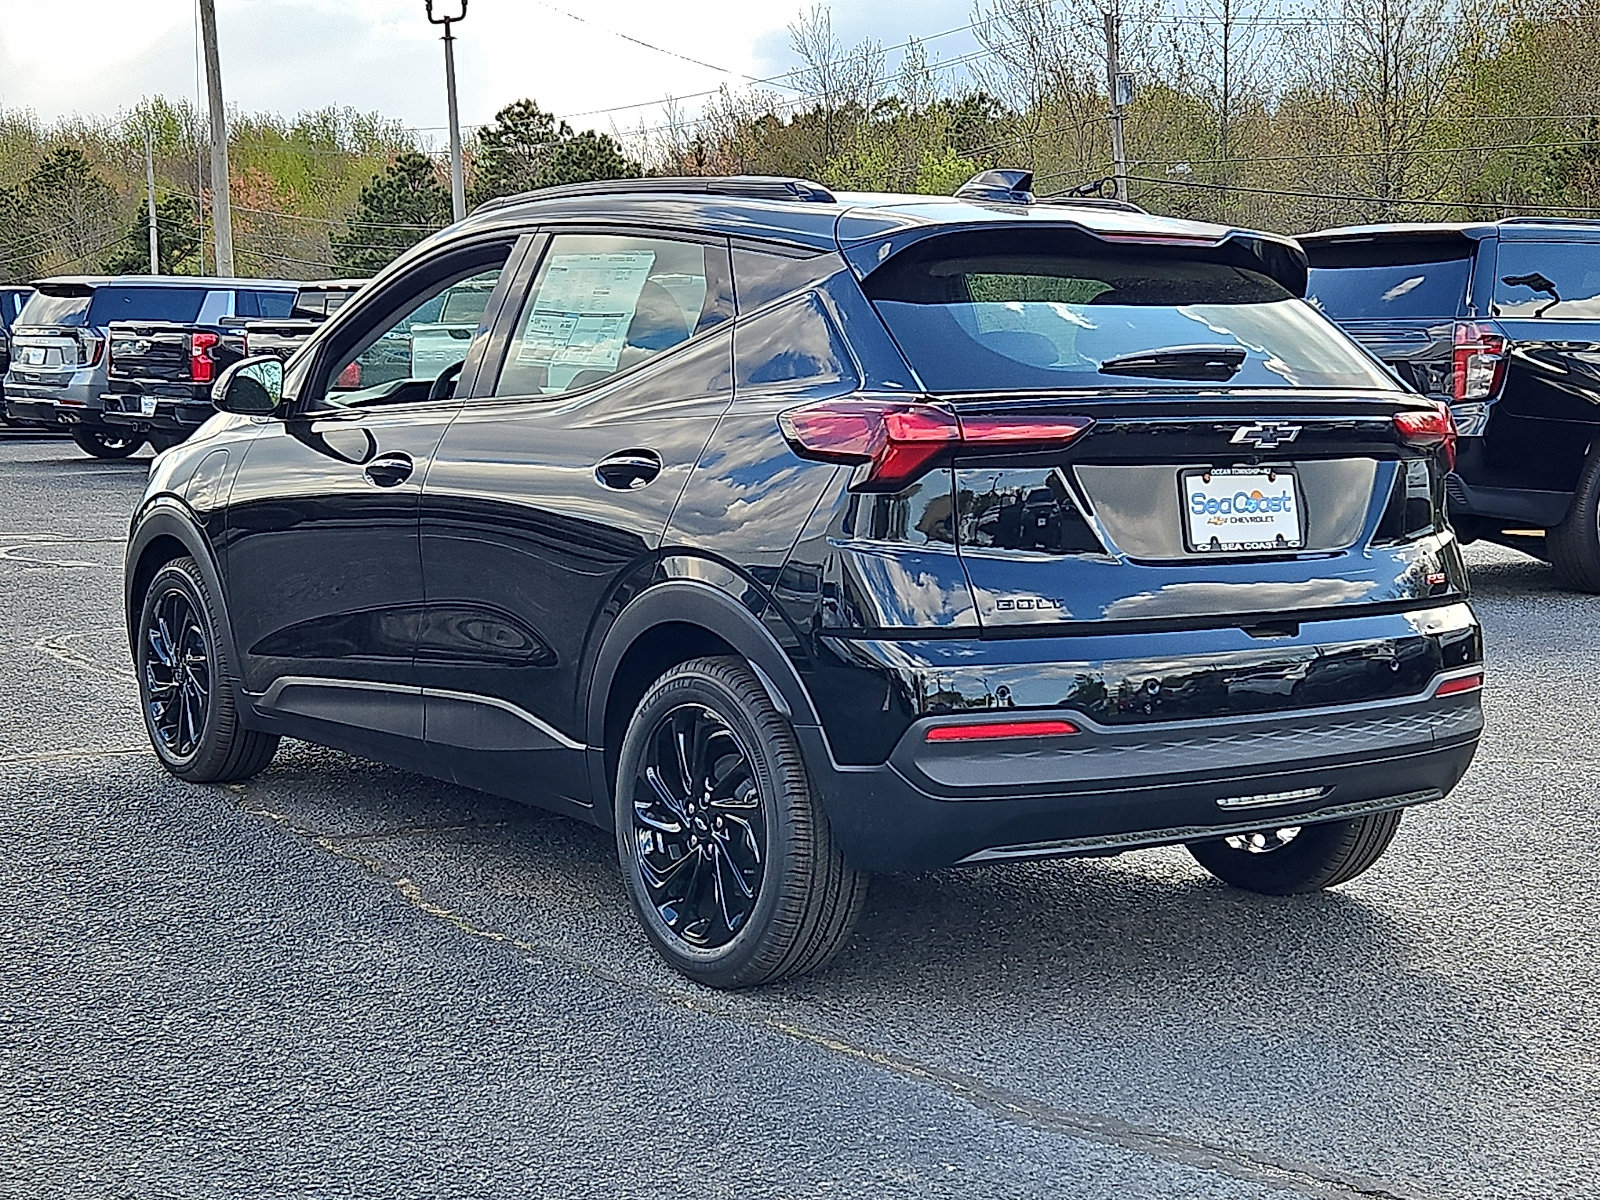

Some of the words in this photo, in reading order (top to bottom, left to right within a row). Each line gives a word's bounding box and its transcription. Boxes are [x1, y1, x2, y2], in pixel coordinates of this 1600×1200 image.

[1229, 515, 1275, 524] CHEVROLET
[1220, 542, 1243, 551] SEA
[1244, 541, 1278, 550] COAST
[996, 598, 1064, 610] BOLT
